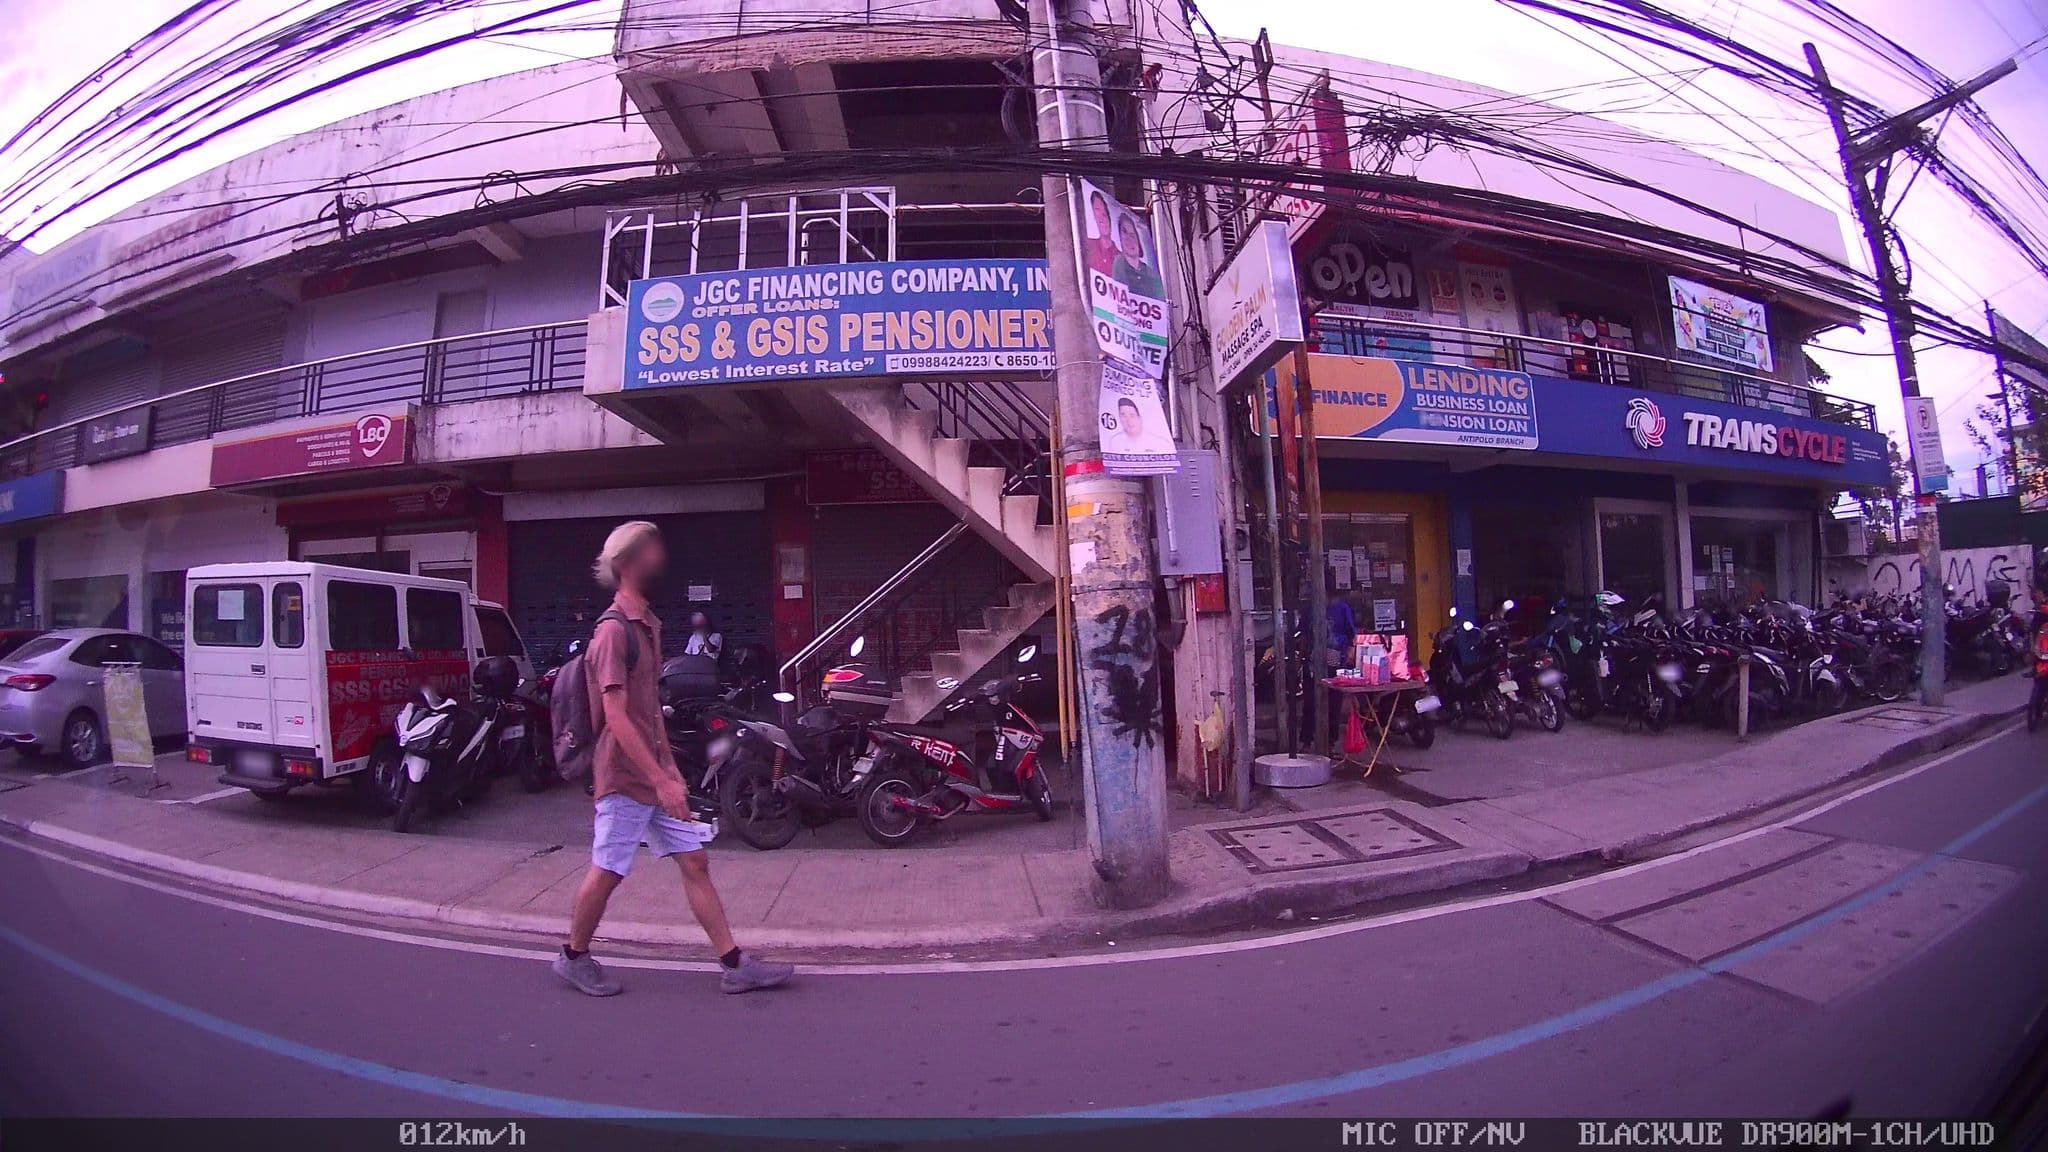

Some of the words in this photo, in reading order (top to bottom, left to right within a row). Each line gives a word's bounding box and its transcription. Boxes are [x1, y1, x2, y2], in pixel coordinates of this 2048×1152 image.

[693, 279, 741, 306] JGC
[747, 270, 884, 301] FINANCING
[891, 267, 1020, 297] COMPANY,
[692, 303, 758, 318] OFFER
[764, 298, 841, 313] LOANS:
[638, 323, 701, 366] SSS
[711, 320, 736, 360] &
[747, 314, 829, 358] GSIS
[1222, 327, 1249, 366] MASSAGE
[1250, 315, 1264, 338] SPA
[726, 361, 808, 379] Interest
[1408, 367, 1529, 400] LENDING
[1312, 390, 1388, 407] FINANCE
[1416, 393, 1485, 411] BUSINESS
[1489, 400, 1528, 415] LOAN
[1102, 413, 1117, 430] 16
[1490, 418, 1528, 433] LOAN
[359, 426, 386, 444] LBC
[1458, 435, 1495, 444] ANTIPOLO
[1496, 437, 1525, 446] BRANCH
[1683, 412, 1847, 464] TRANSCYCLE
